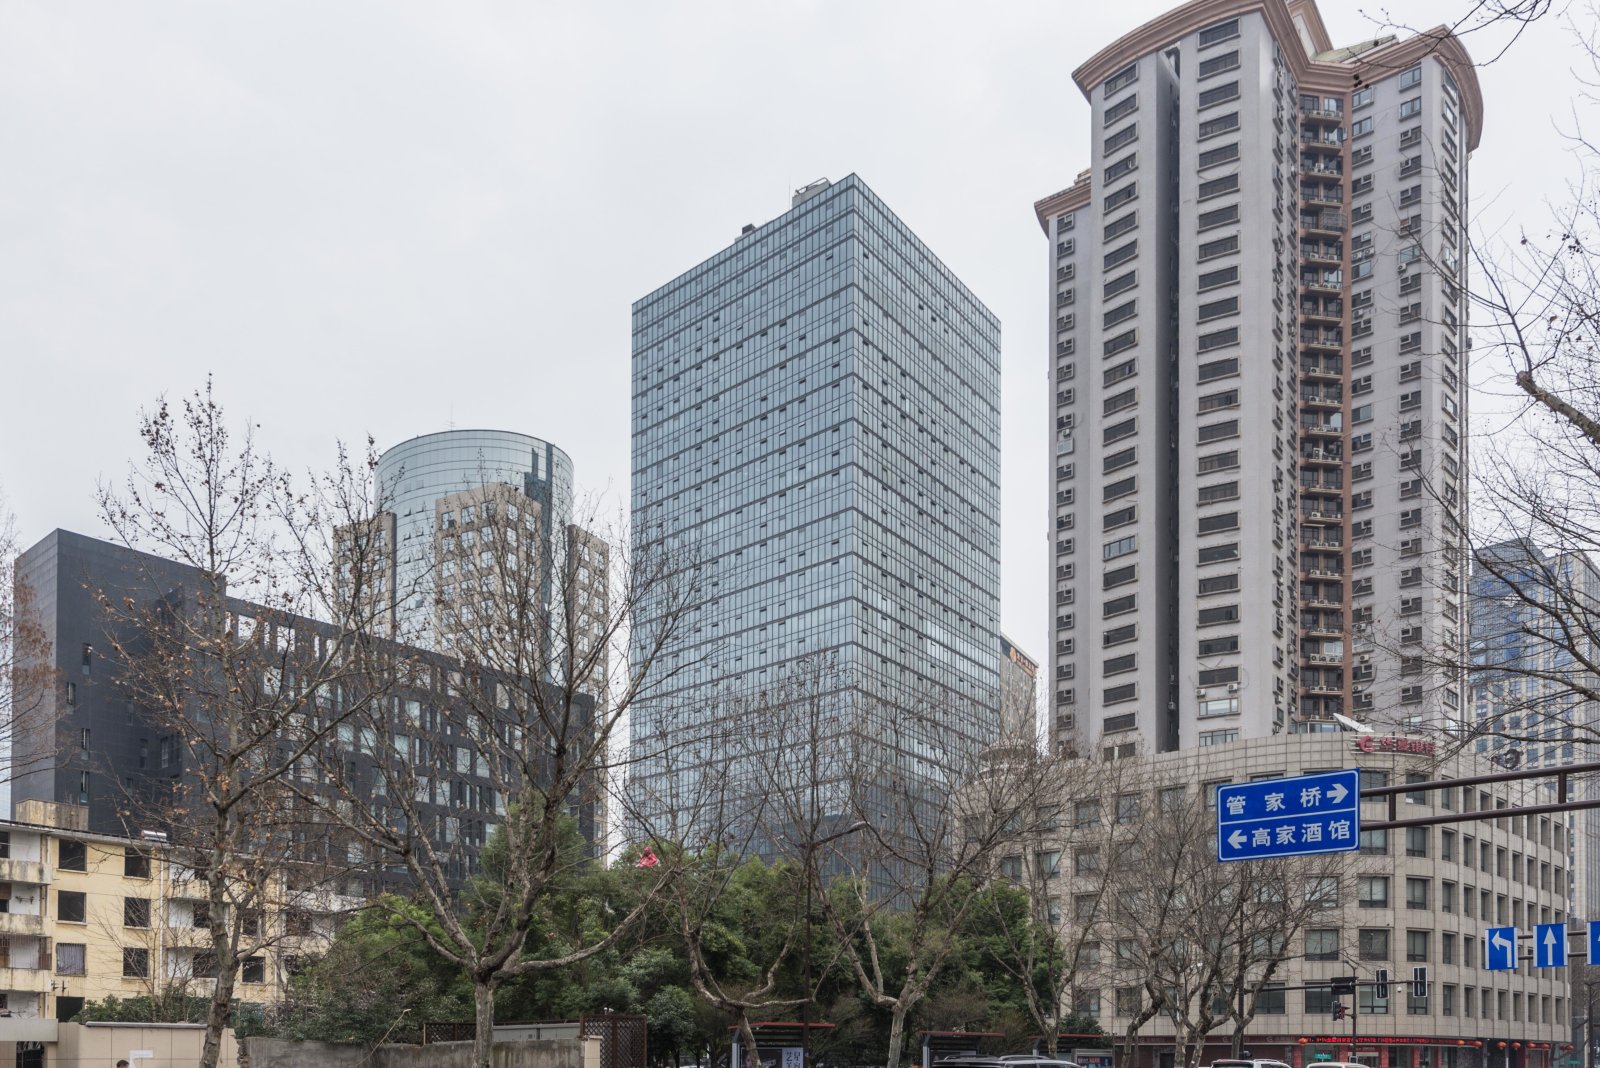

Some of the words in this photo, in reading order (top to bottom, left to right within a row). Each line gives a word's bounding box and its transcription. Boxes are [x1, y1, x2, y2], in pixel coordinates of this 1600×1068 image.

[1226, 786, 1322, 816] 管家桥
[1251, 819, 1350, 848] 高家酒馆
